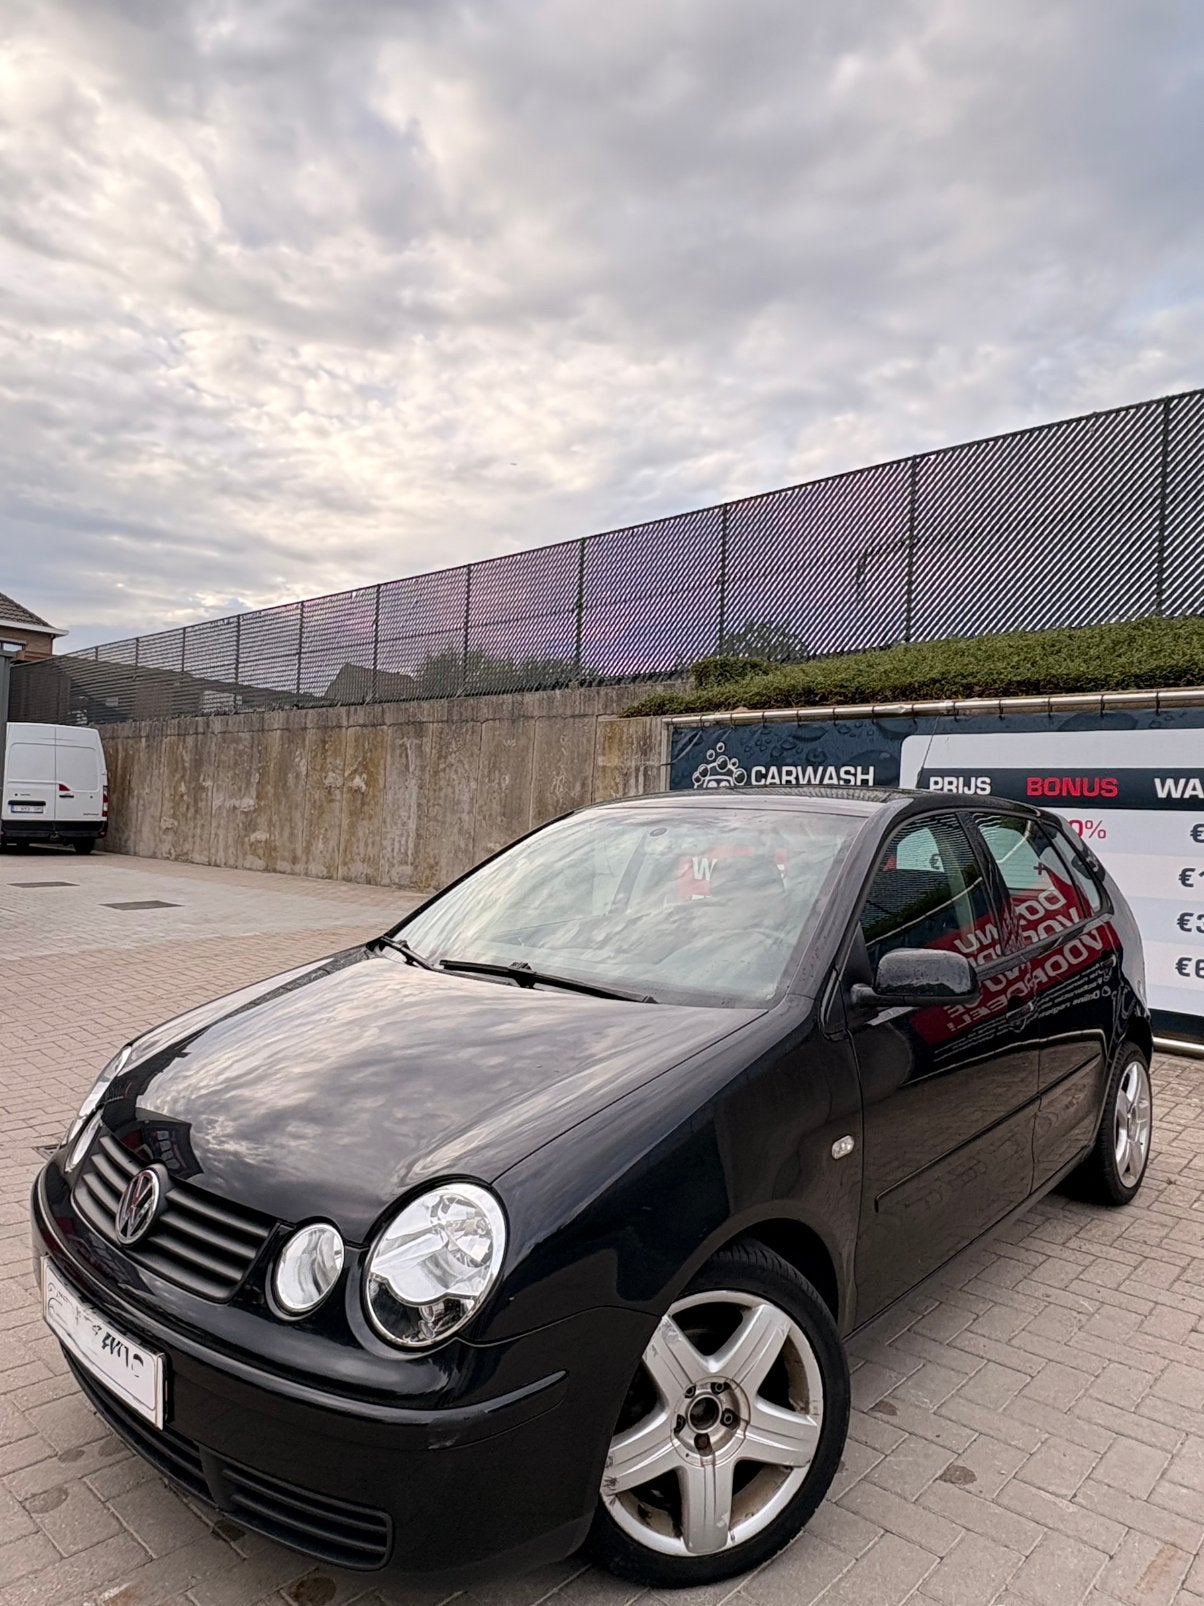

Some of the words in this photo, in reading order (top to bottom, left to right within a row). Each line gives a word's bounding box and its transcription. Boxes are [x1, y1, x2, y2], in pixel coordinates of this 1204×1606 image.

[750, 764, 875, 787] CARWASH
[928, 775, 993, 797] PRIJS
[1025, 776, 1120, 799] BONUS
